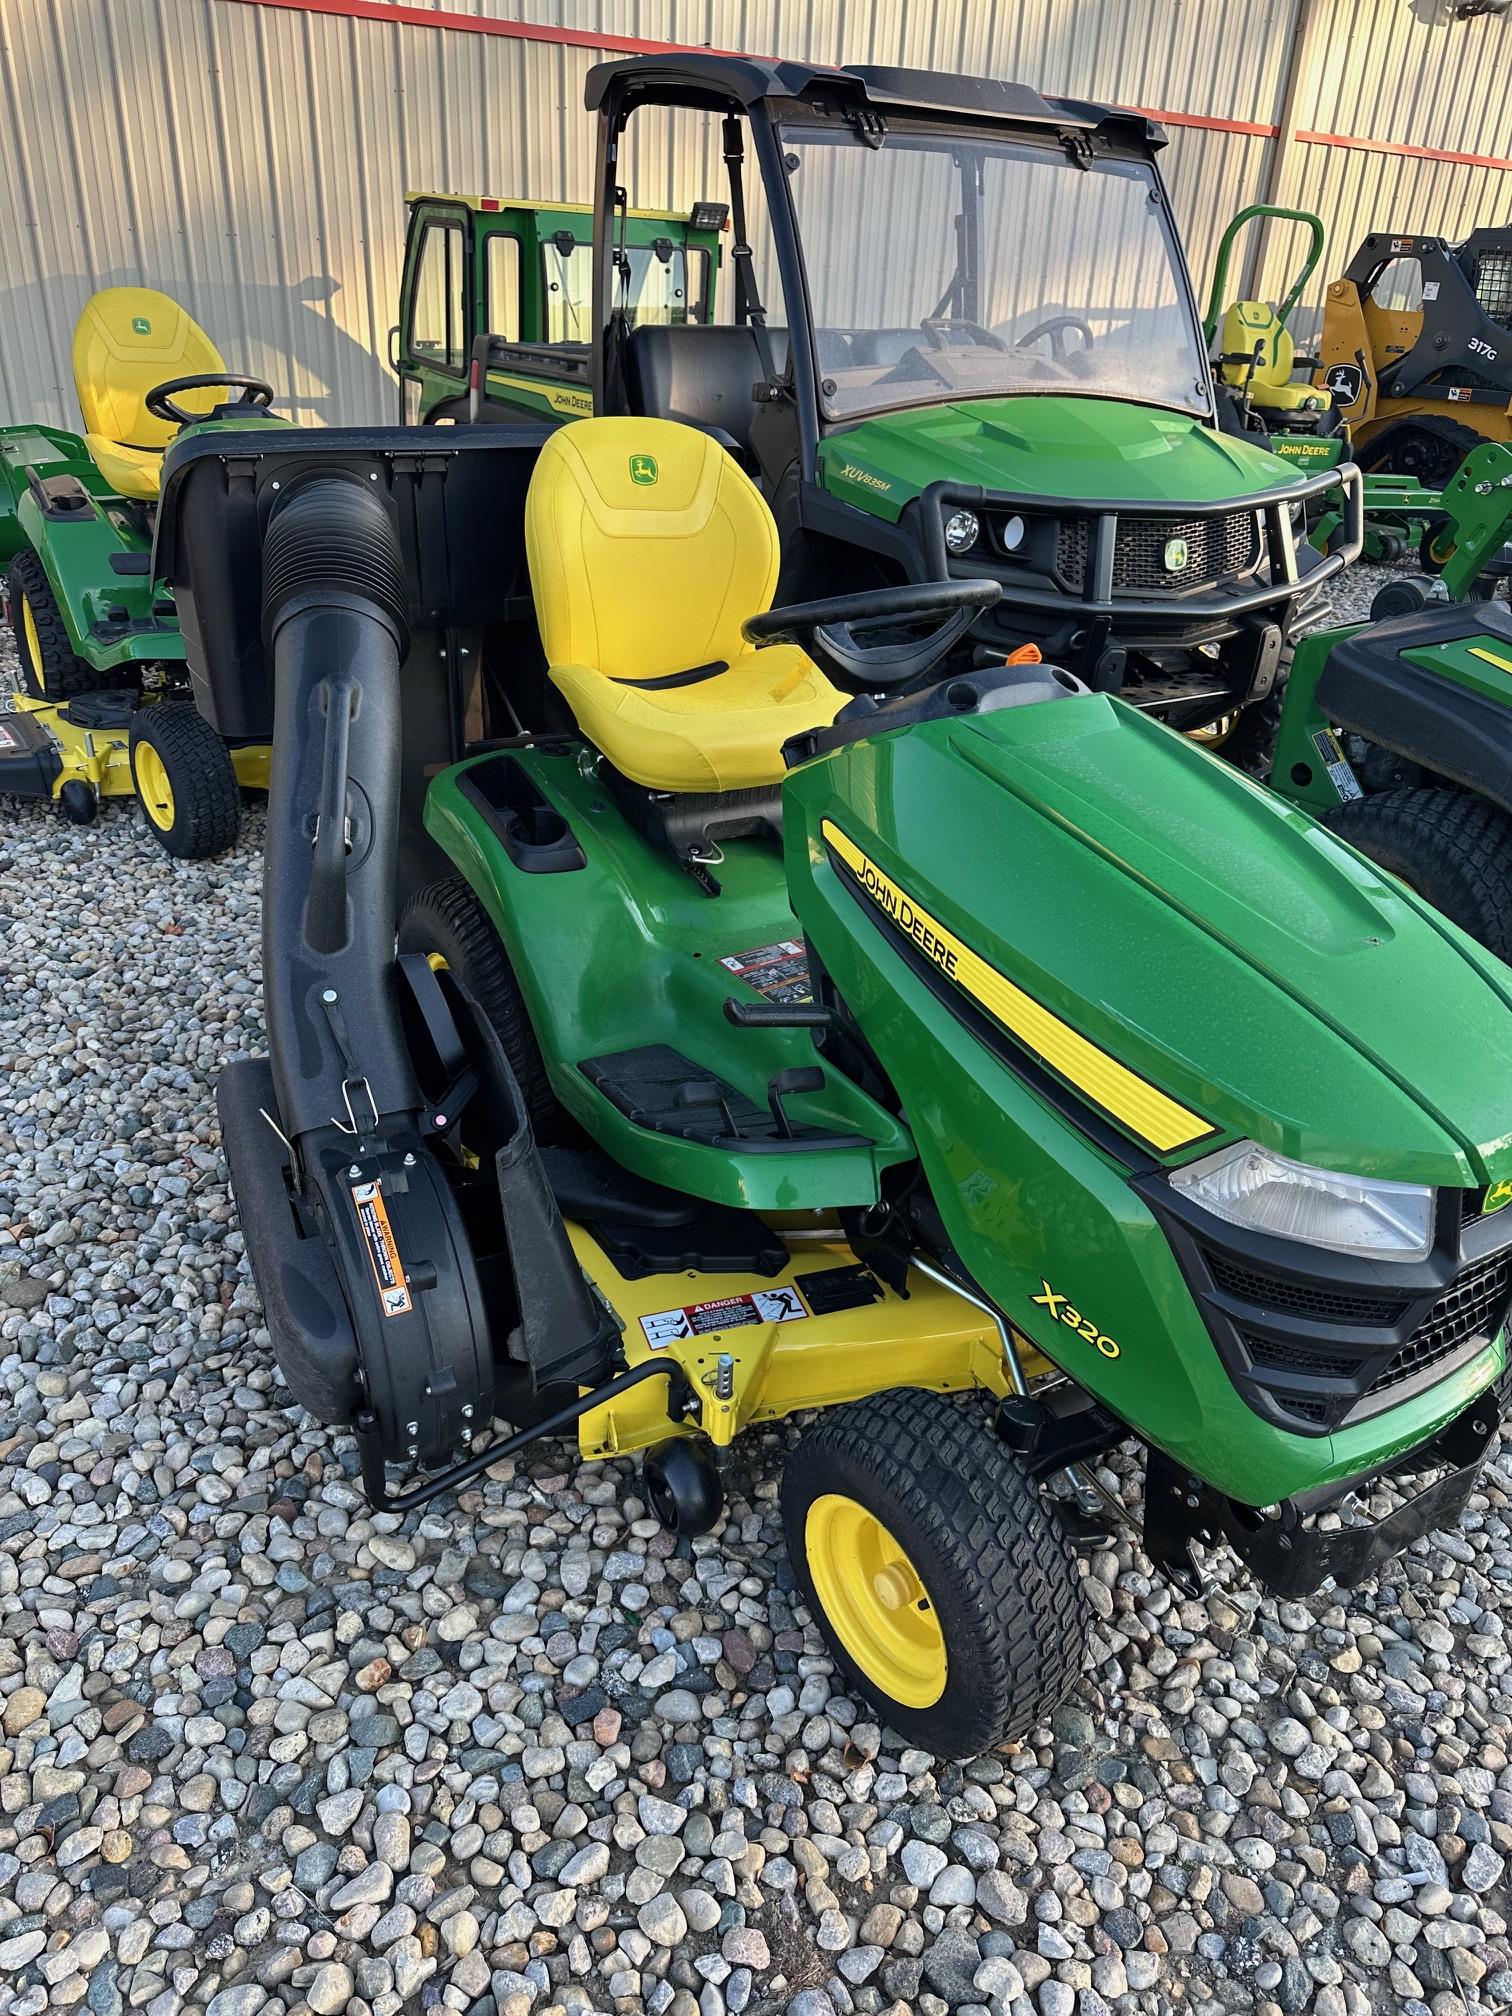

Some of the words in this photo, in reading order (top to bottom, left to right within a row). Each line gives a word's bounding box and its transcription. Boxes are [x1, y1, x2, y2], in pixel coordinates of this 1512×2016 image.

[1468, 337, 1498, 360] 317G
[554, 393, 571, 406] JOHN
[572, 396, 593, 410] DEERE
[1278, 444, 1302, 454] JOHN
[1302, 445, 1331, 456] DEERE
[840, 464, 893, 491] XUV835M
[857, 859, 898, 917] JOHN
[899, 900, 959, 977] DEERE
[381, 1224, 397, 1259] WARNING
[703, 1297, 743, 1310] DANGER
[1029, 1277, 1121, 1359] X320
